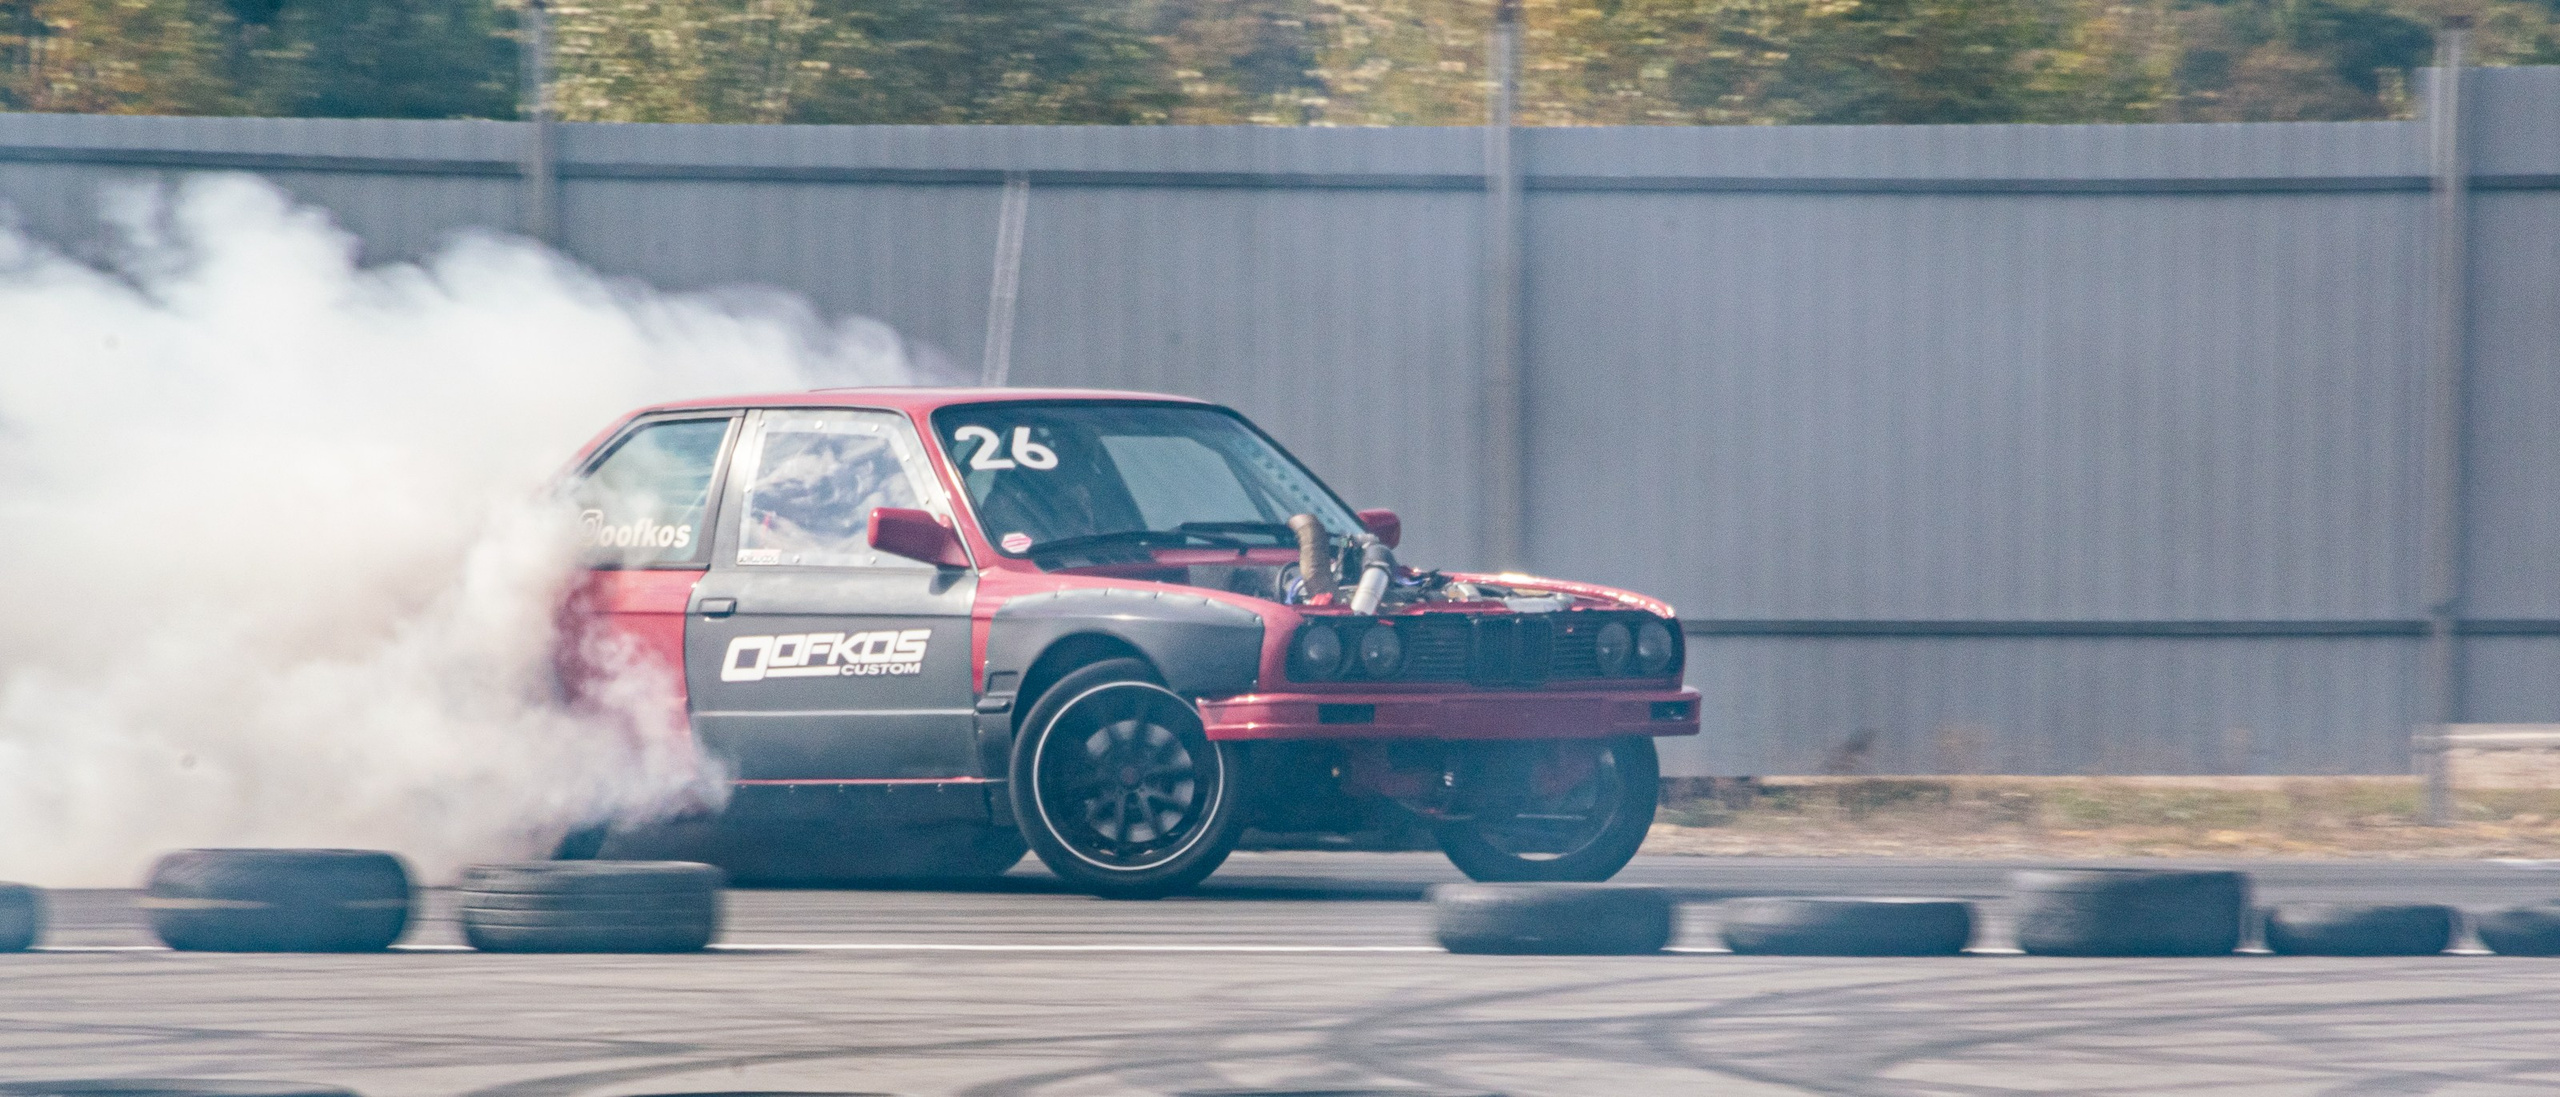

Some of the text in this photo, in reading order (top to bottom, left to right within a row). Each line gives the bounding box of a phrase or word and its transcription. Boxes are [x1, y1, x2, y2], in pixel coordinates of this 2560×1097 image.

[954, 425, 1059, 470] 26
[600, 518, 692, 549] oofkos
[840, 662, 922, 676] CUSTOM
